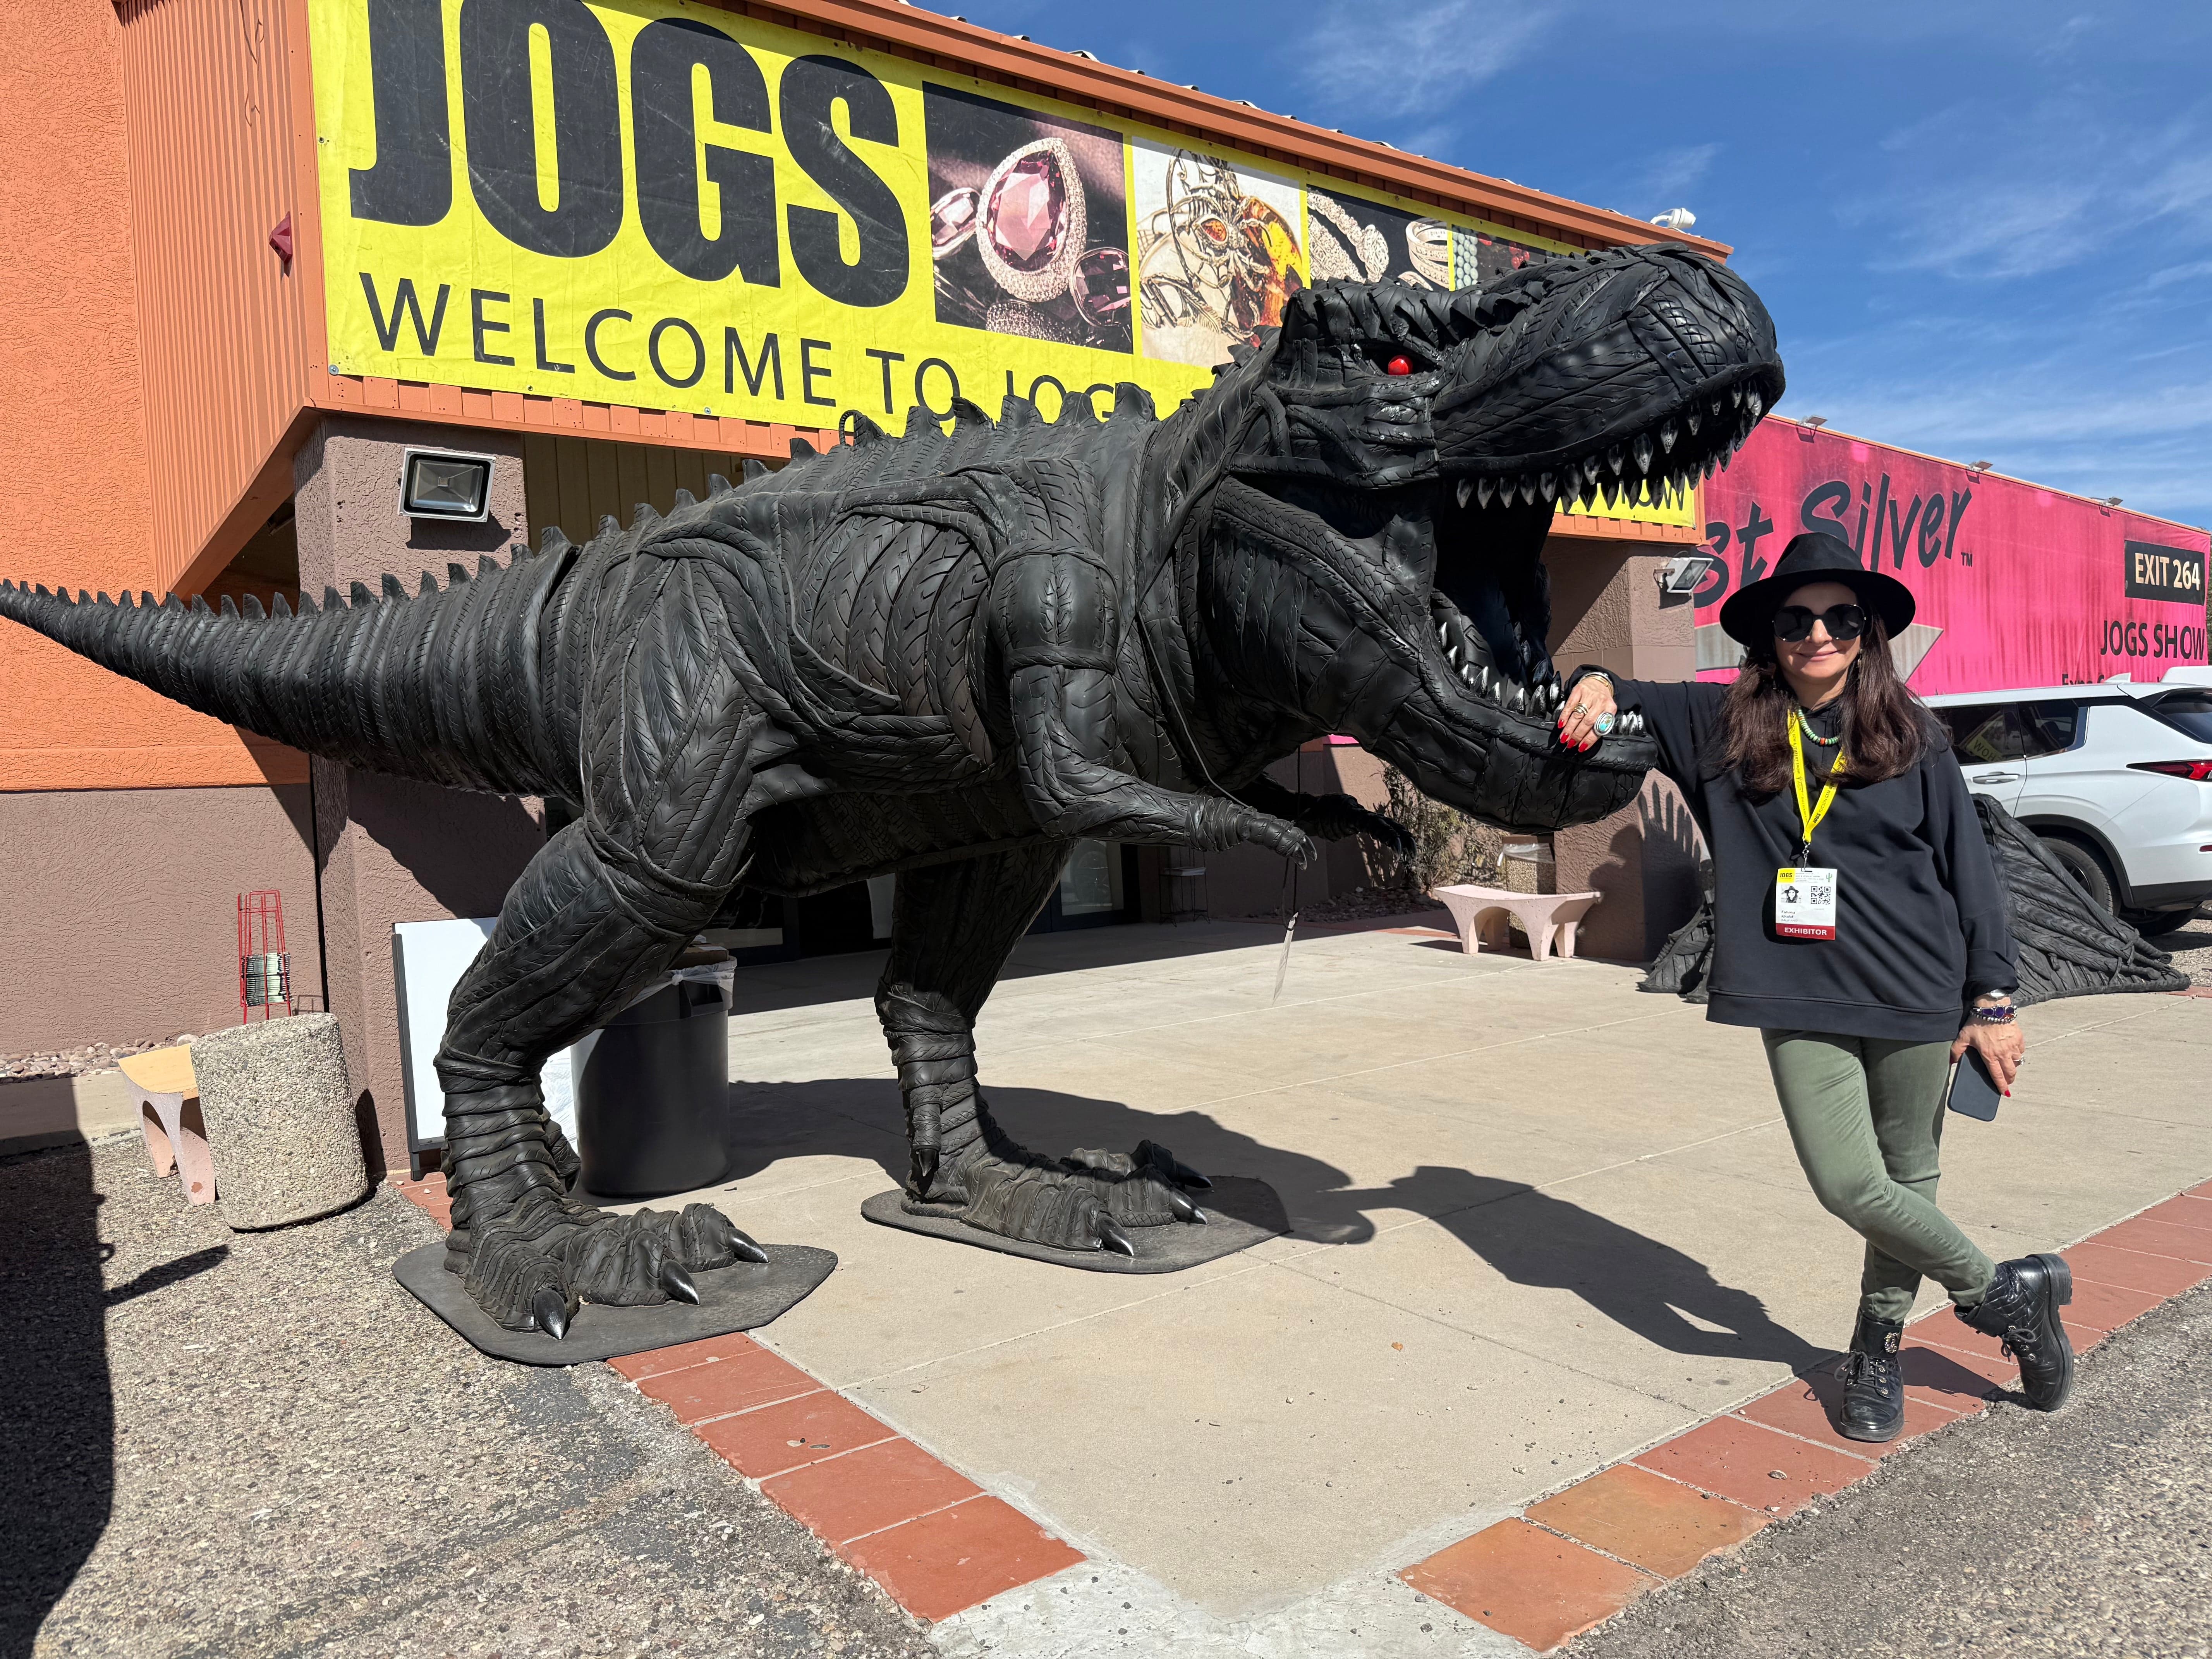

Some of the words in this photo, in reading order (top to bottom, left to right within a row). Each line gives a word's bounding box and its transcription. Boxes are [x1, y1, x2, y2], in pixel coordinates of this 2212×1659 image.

[349, 0, 909, 307] JOGS
[359, 272, 836, 407] WELCOME
[866, 349, 960, 421] TO
[1801, 472, 1972, 572] Silver
[2135, 553, 2169, 586] EXIT
[2173, 559, 2200, 591] 264
[2100, 620, 2148, 657] JOGS
[2154, 624, 2205, 660] SHOW
[1813, 812, 1821, 823] JOGS
[1784, 927, 1827, 936] EXHIBITOR
